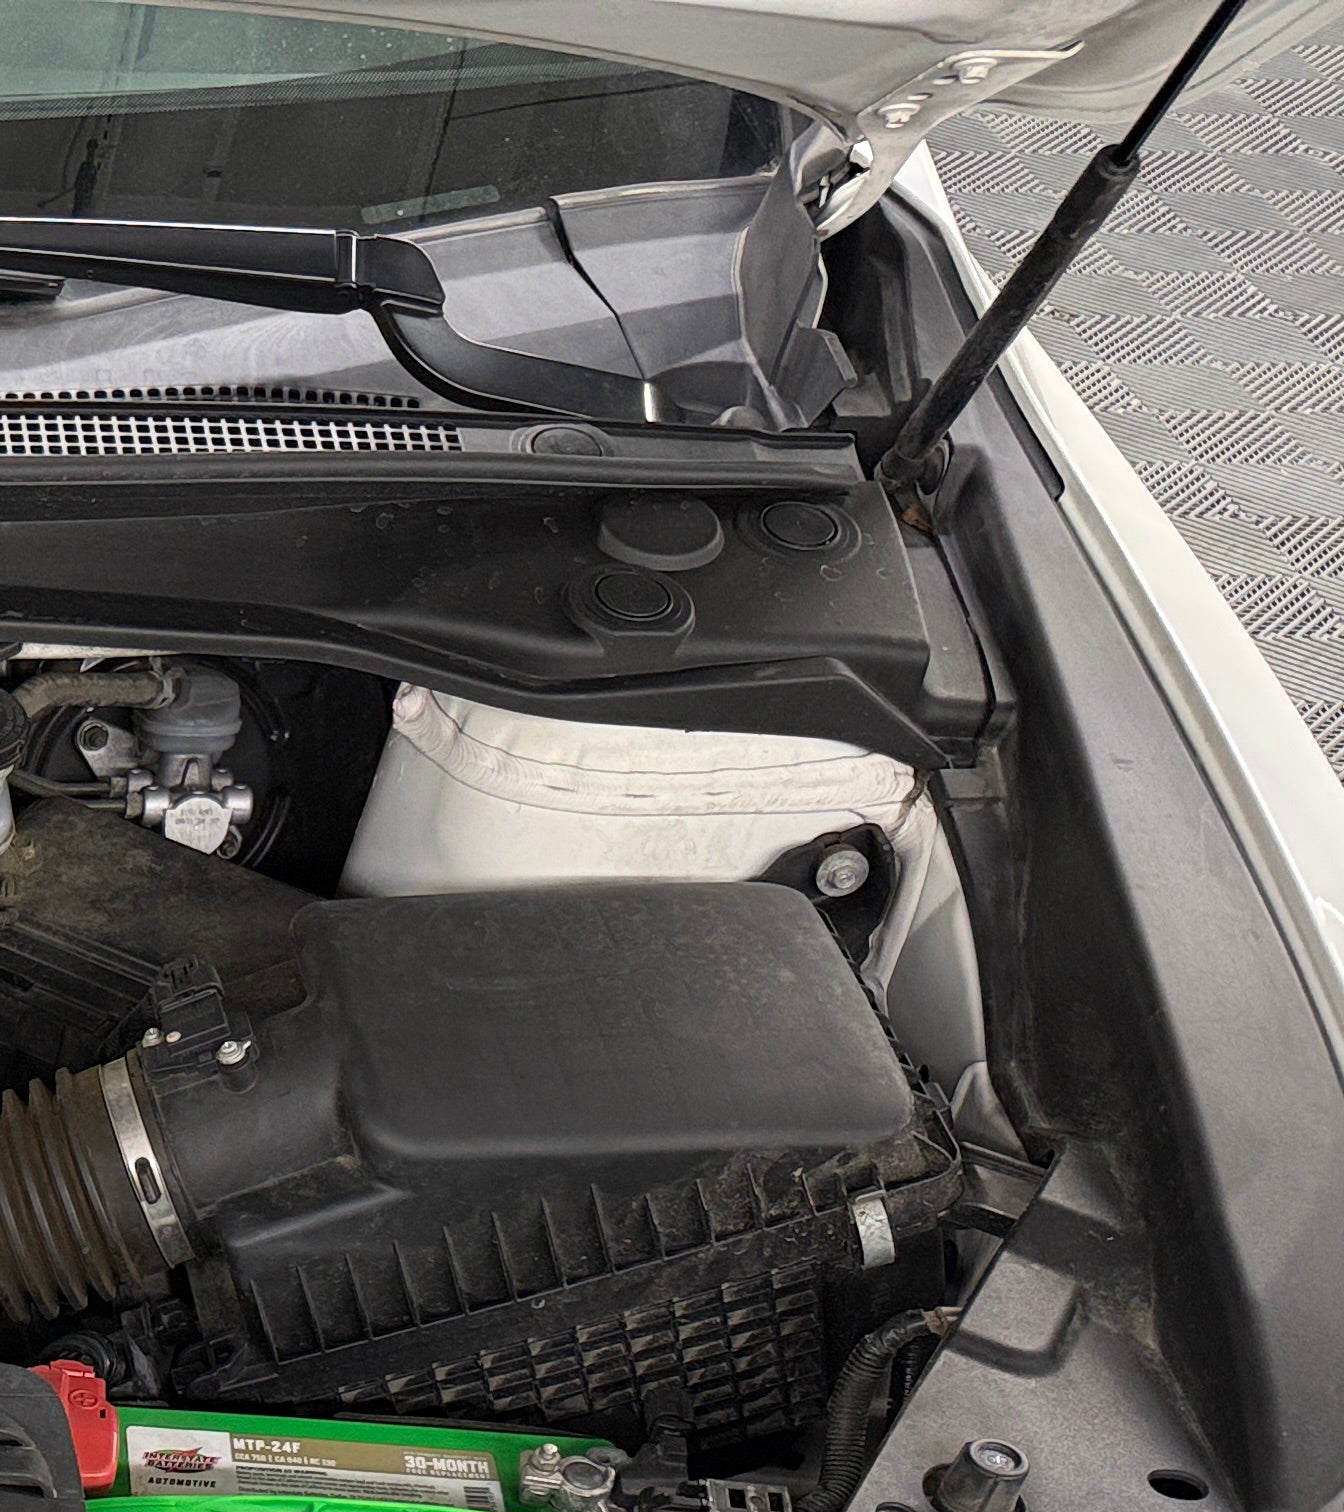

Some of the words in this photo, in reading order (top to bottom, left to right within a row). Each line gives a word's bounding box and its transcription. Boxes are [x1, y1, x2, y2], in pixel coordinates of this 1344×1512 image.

[232, 1438, 301, 1453] MTP-24F
[142, 1451, 220, 1465] INTERSTATE
[234, 1452, 250, 1461] CCA
[274, 1455, 286, 1463] CA
[403, 1455, 489, 1473] 30-MONTH
[144, 1459, 215, 1471] BATTERIES
[147, 1476, 217, 1488] AUTOMOTIVE
